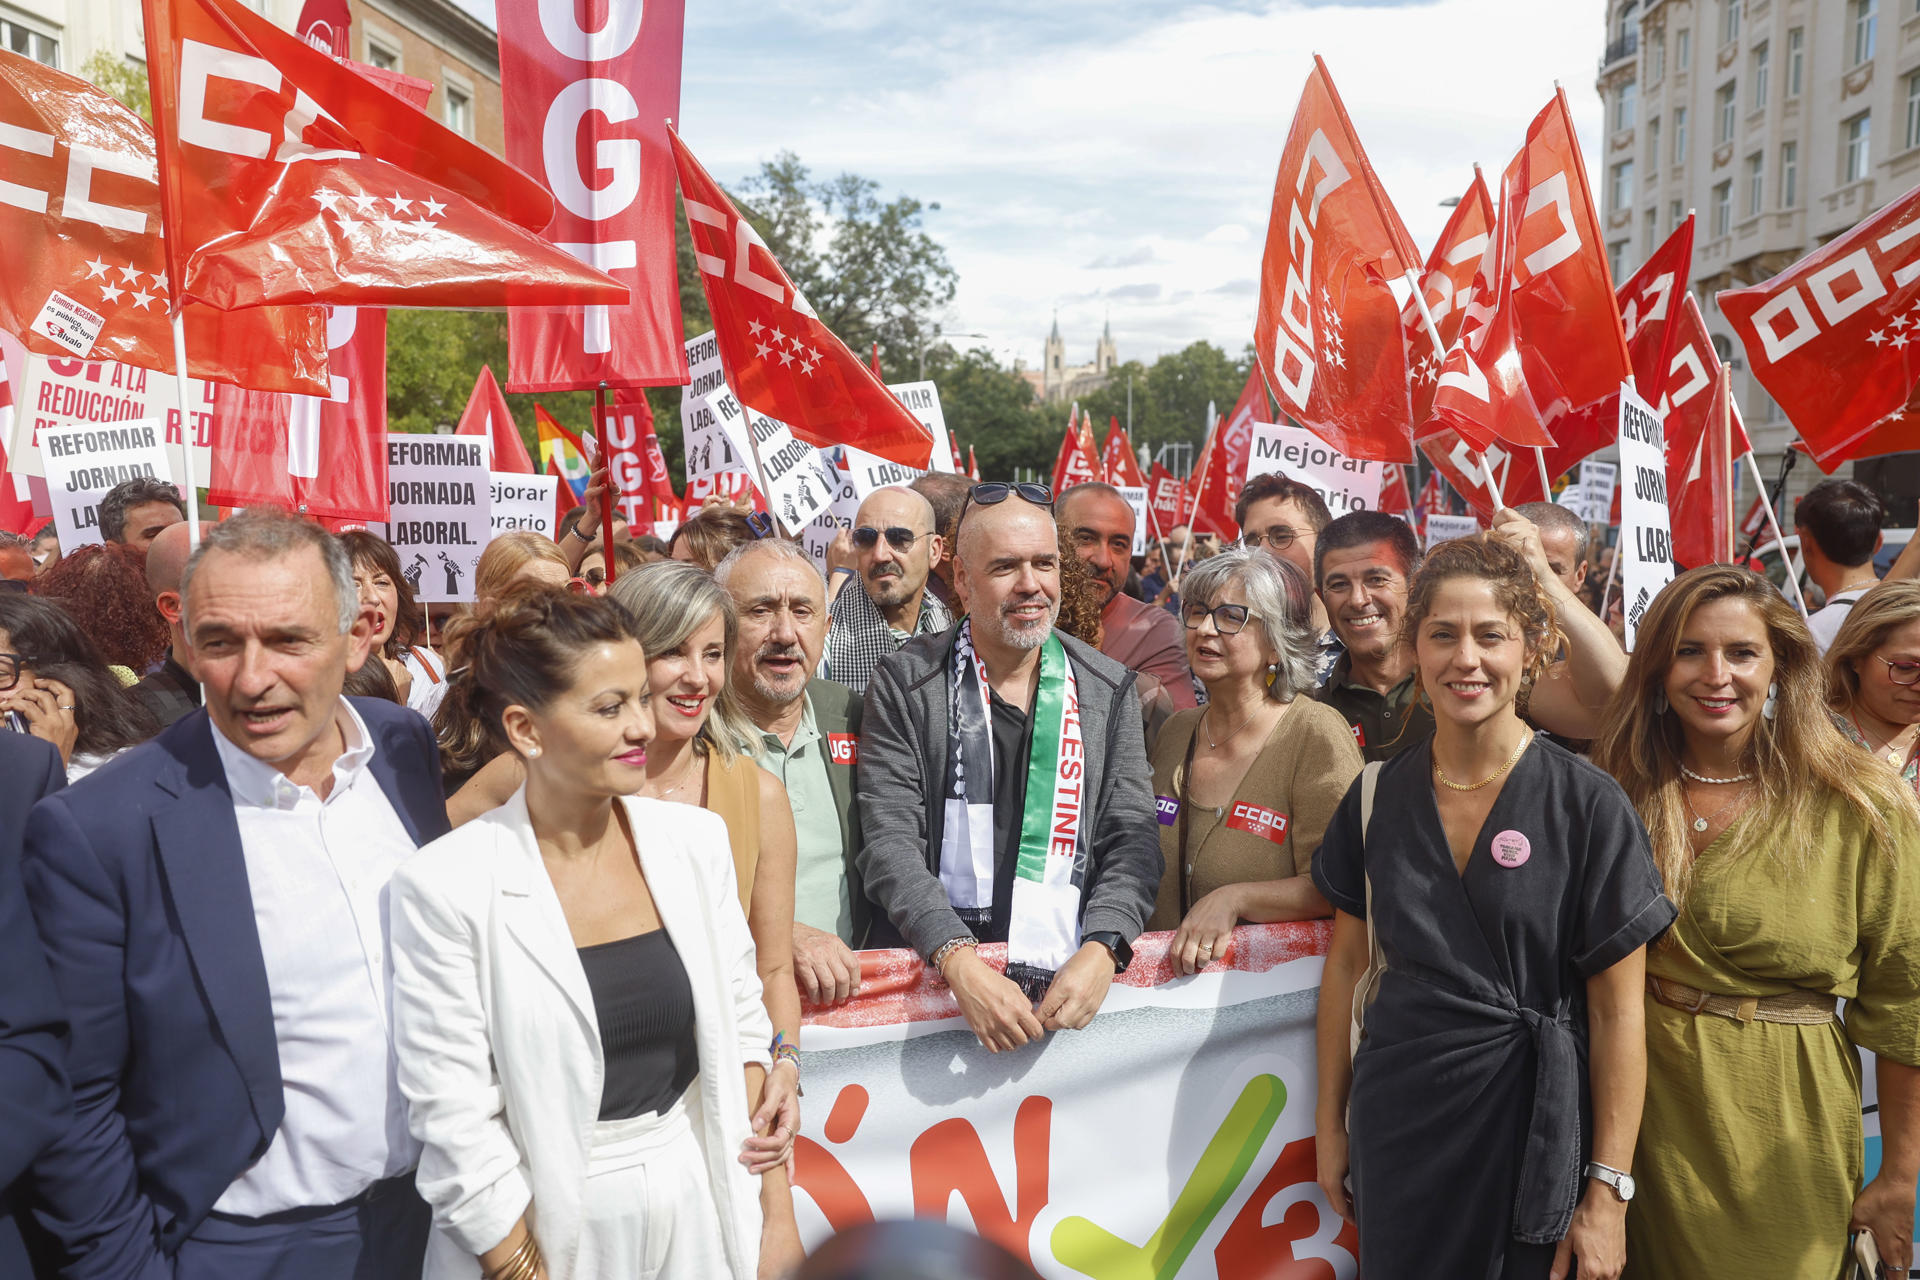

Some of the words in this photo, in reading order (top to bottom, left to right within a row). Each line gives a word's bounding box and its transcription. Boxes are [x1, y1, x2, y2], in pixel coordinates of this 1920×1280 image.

[690, 368, 726, 400] JORNA
[37, 380, 145, 423] REDUCCIÓN
[48, 426, 157, 457] REFORMAR
[1256, 436, 1373, 475] Mejorar
[606, 415, 645, 526] UGT
[390, 481, 476, 506] JORNADA
[71, 503, 101, 530] LA
[1233, 804, 1287, 831] CCOO
